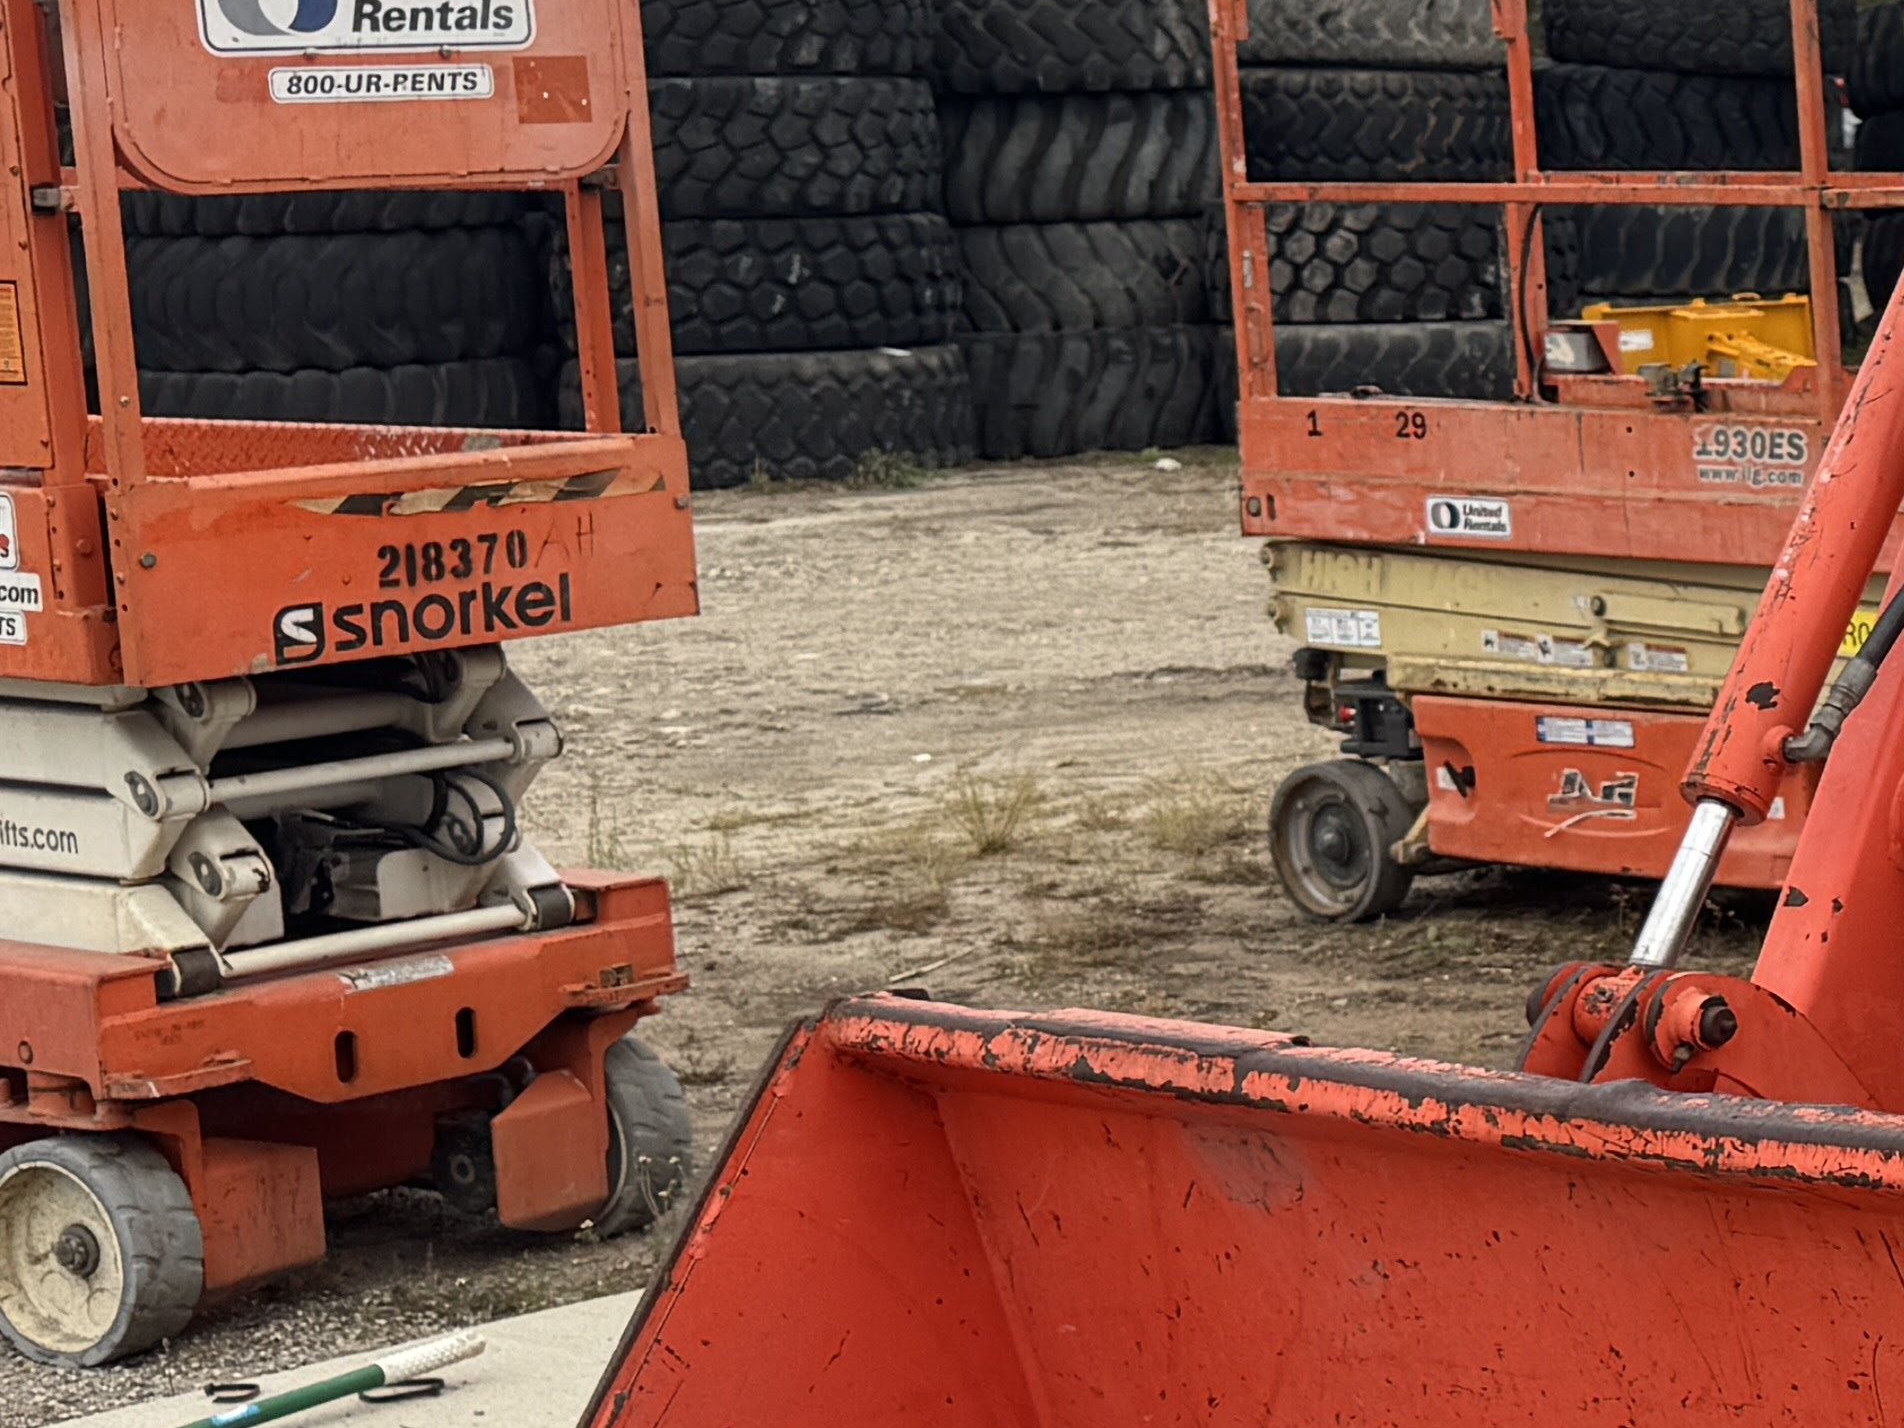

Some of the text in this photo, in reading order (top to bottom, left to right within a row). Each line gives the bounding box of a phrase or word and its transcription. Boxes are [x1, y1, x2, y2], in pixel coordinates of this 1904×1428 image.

[1463, 503, 1503, 517] United
[1464, 517, 1507, 532] Rentals
[377, 529, 528, 588] 218370
